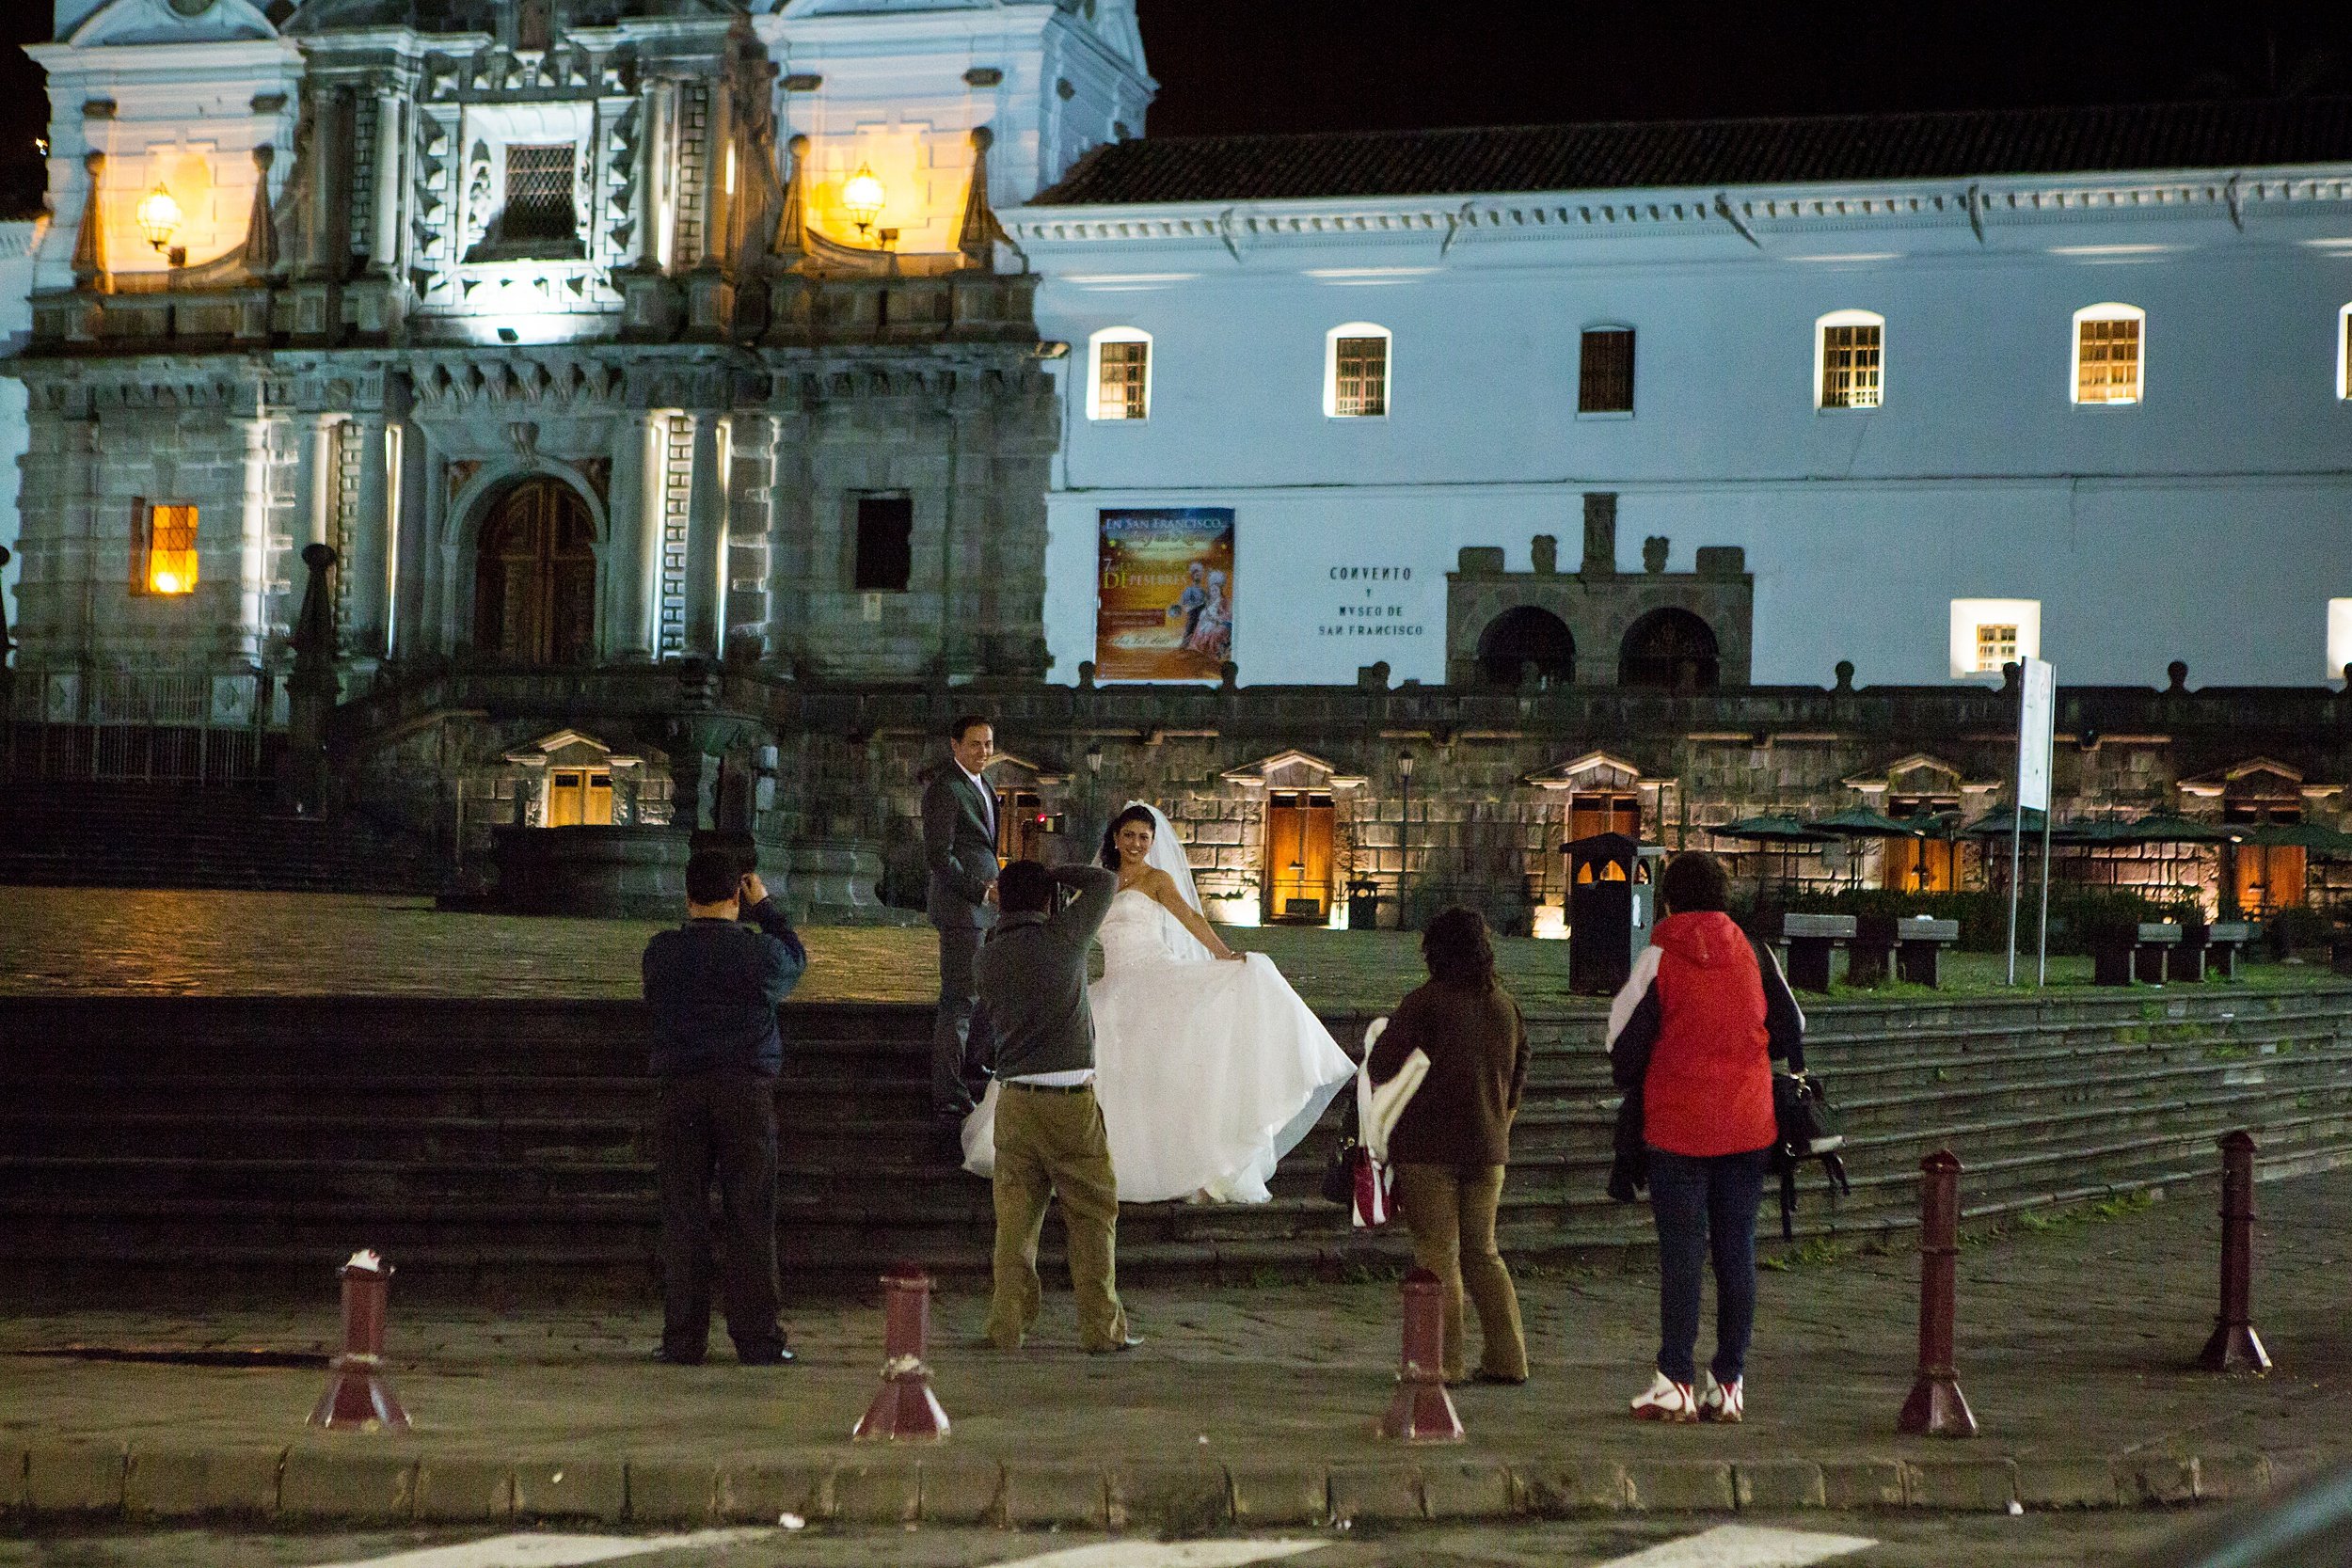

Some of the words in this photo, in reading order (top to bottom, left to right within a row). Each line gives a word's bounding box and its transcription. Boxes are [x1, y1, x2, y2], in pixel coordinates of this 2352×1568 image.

[1126, 518, 1150, 529] SAN
[1329, 567, 1411, 580] CONVENTO
[1388, 606, 1403, 617] DE
[1318, 625, 1343, 636] SAN
[1348, 625, 1423, 636] FRANCISCO
